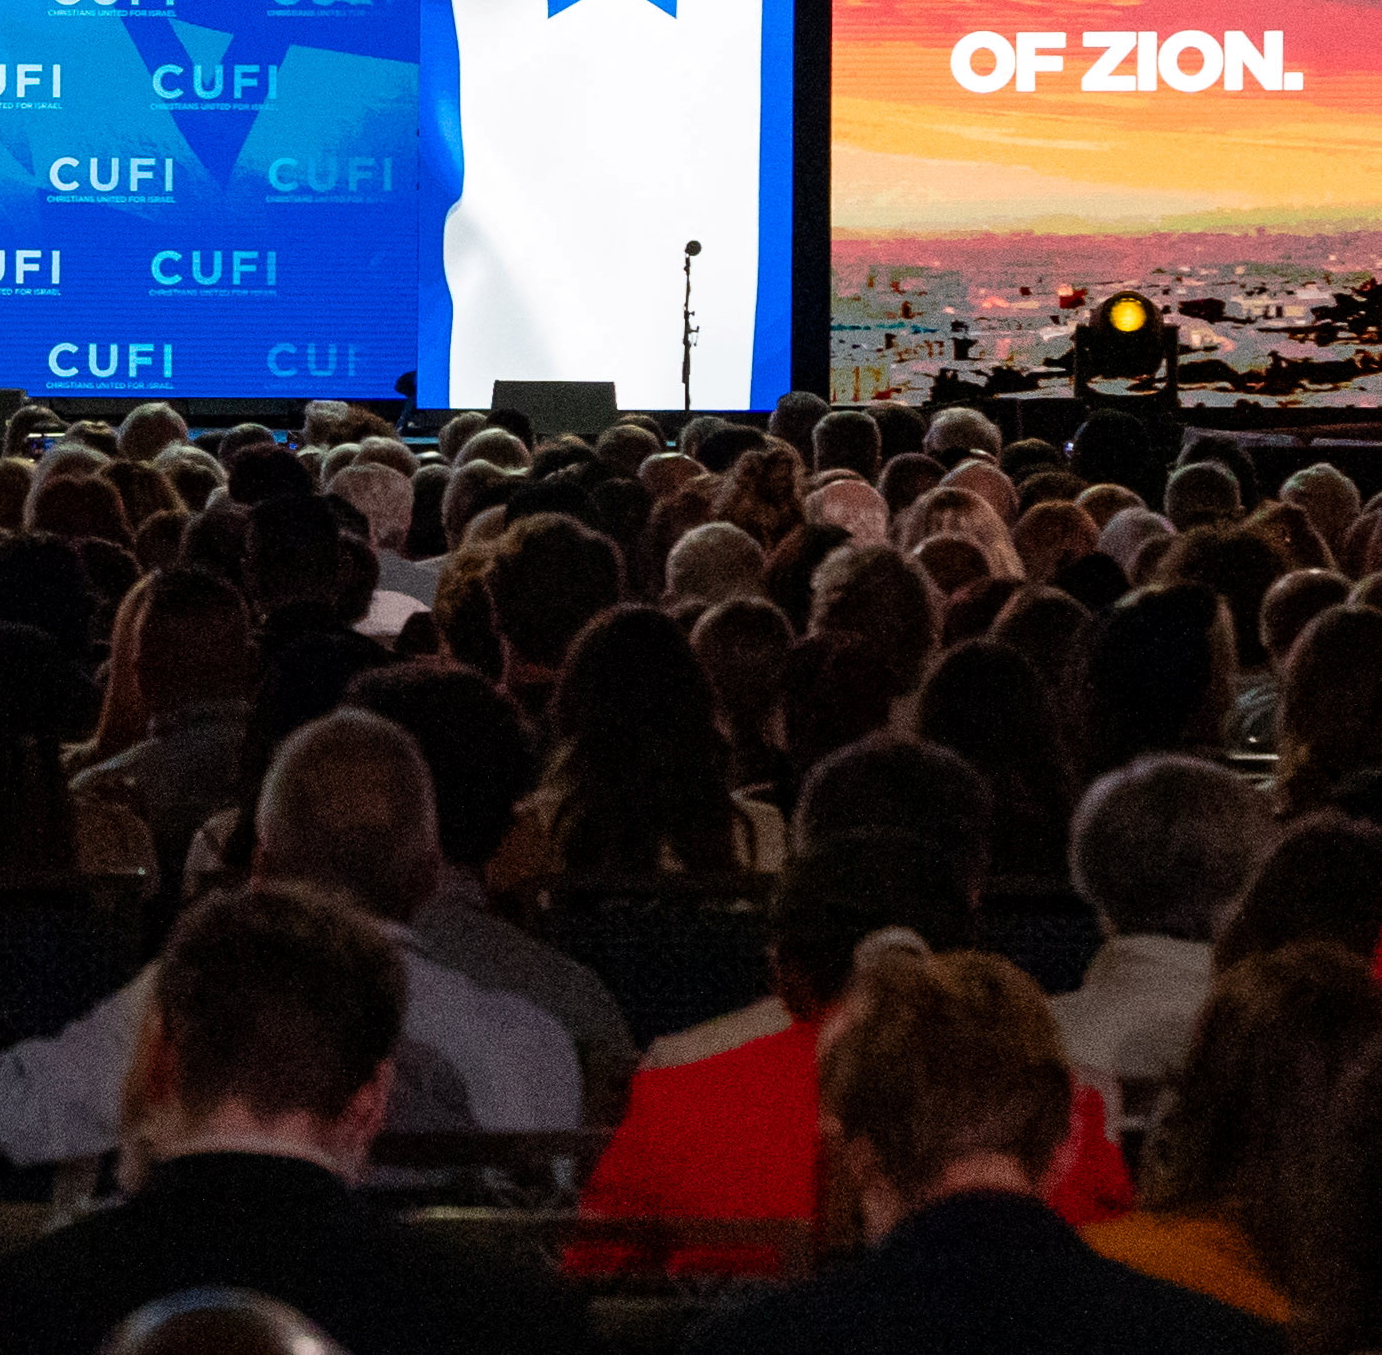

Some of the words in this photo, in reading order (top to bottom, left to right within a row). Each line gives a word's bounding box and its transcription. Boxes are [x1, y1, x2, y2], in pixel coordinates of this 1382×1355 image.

[950, 30, 1067, 93] OF
[1081, 29, 1304, 92] ZION.
[152, 64, 277, 99] CUFI
[49, 157, 173, 192] CUFI
[151, 251, 275, 286] CUFI
[49, 343, 171, 378] CUFI
